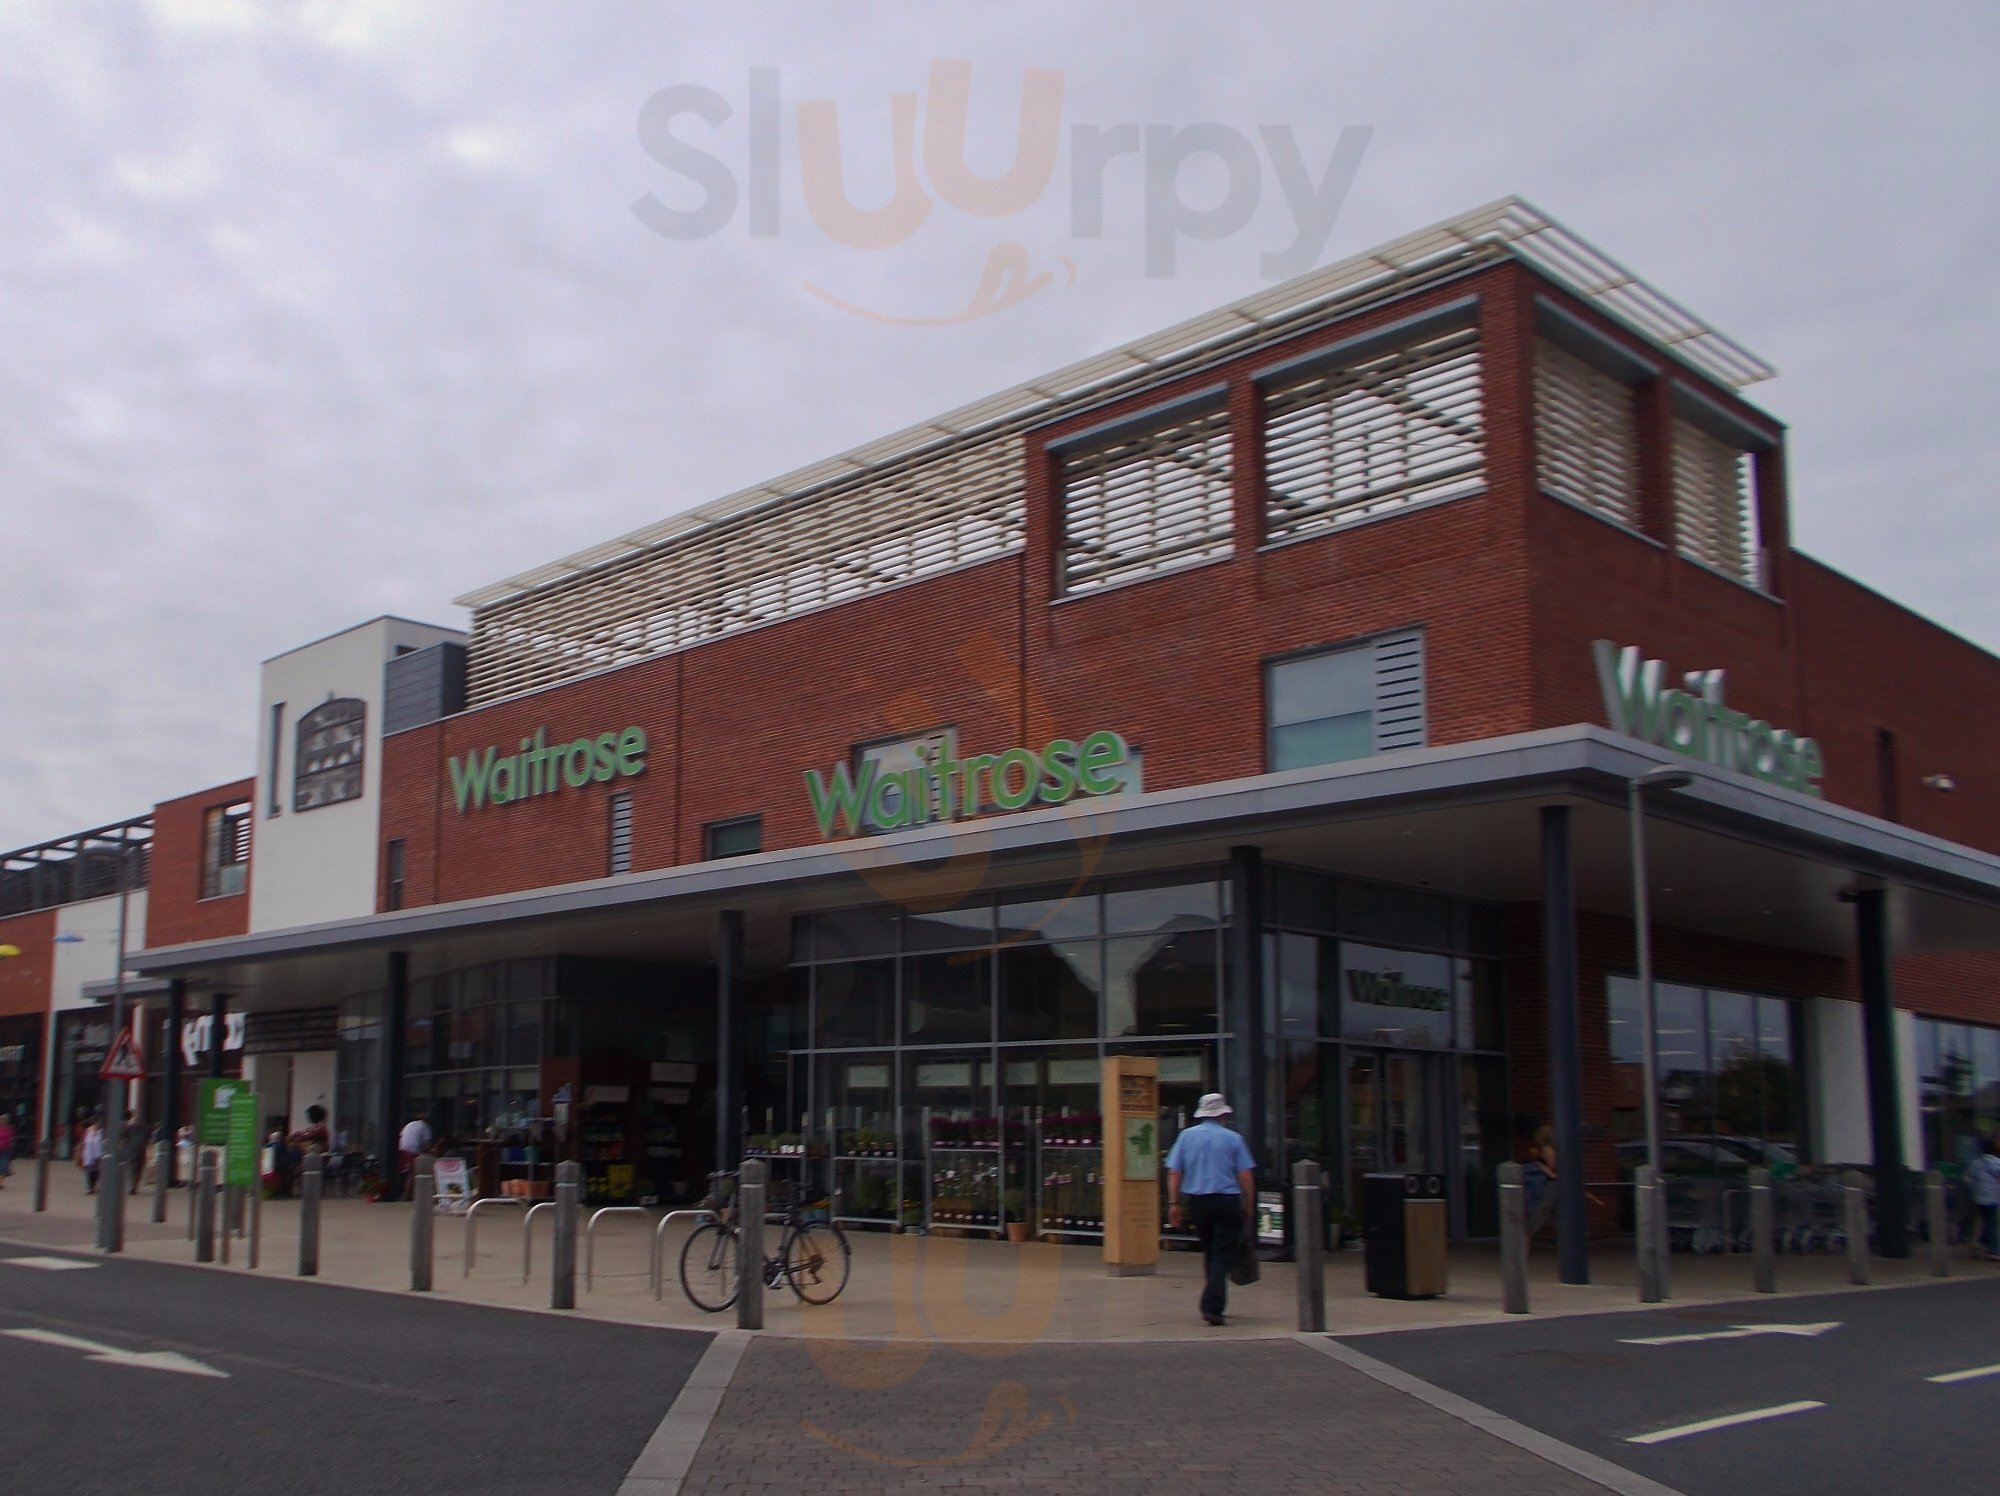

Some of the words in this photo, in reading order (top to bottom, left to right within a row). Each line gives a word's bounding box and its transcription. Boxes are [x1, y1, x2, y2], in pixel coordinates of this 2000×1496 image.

[448, 725, 647, 815] Waitrose
[1591, 638, 1824, 800] Waitrose
[803, 730, 1128, 839] Waitrose
